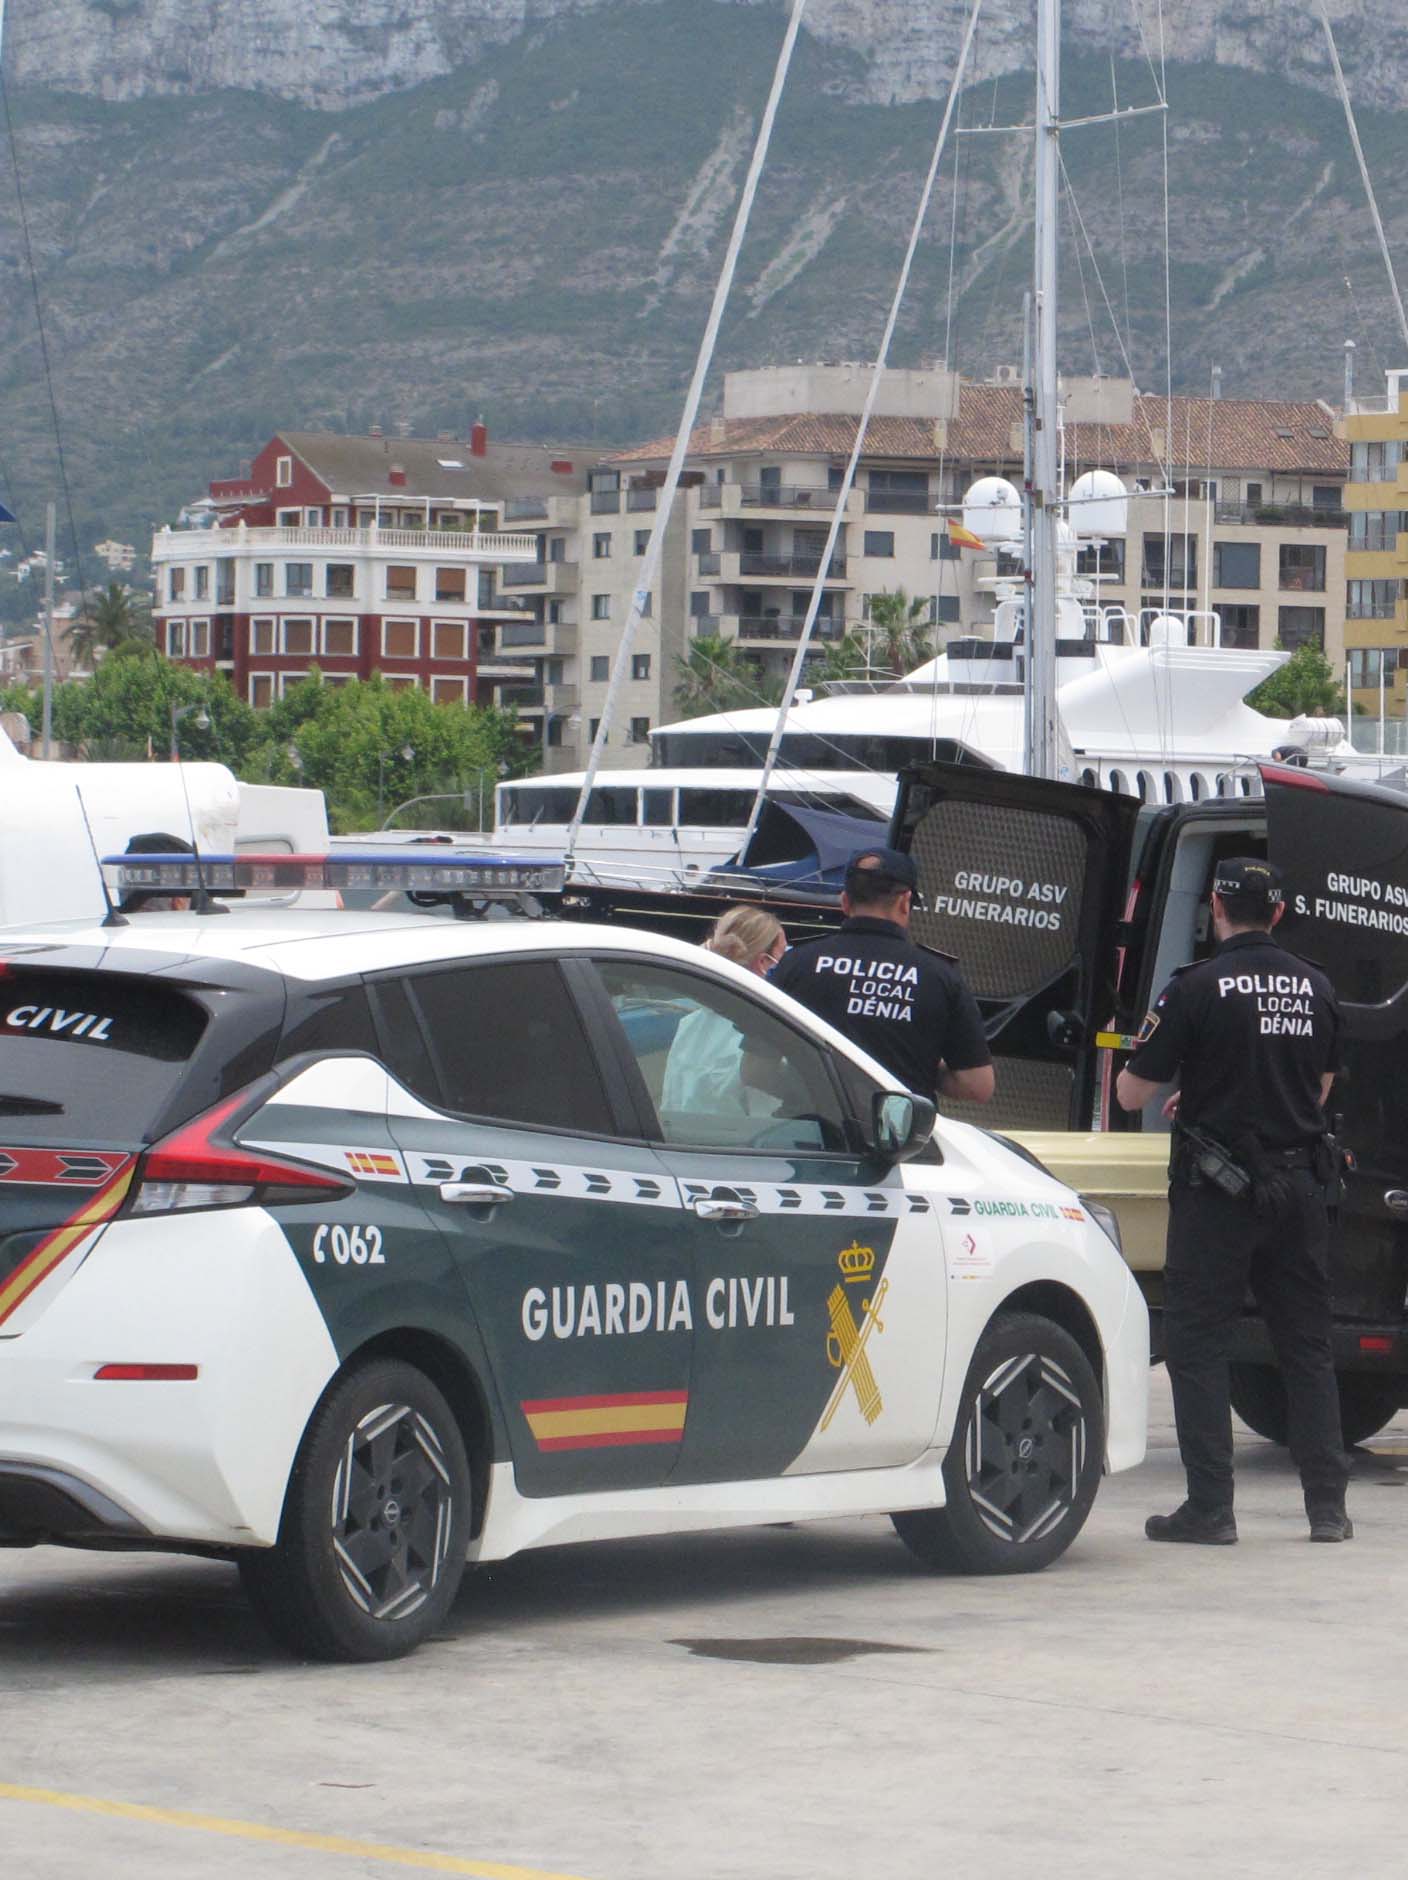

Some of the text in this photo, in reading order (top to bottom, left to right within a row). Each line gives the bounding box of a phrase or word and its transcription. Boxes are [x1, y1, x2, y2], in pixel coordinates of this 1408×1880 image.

[954, 871, 1067, 903] GRUPO ASV
[1327, 872, 1381, 900] GRUPO
[934, 895, 1061, 930] FUNERARIOS
[1295, 895, 1311, 915] S.
[815, 956, 918, 984] POLICIA
[849, 979, 915, 1002] LOCAL
[1218, 974, 1314, 998] POLICIA
[847, 996, 912, 1022] DÉNIA
[1257, 997, 1314, 1015] LOCAL
[6, 1005, 114, 1040] CIVIL
[1260, 1013, 1313, 1037] DÉNIA
[974, 1200, 1059, 1219] GUARDIA CIVIL
[331, 1224, 386, 1265] 062
[521, 1276, 795, 1342] GUARDIA CIVIL
